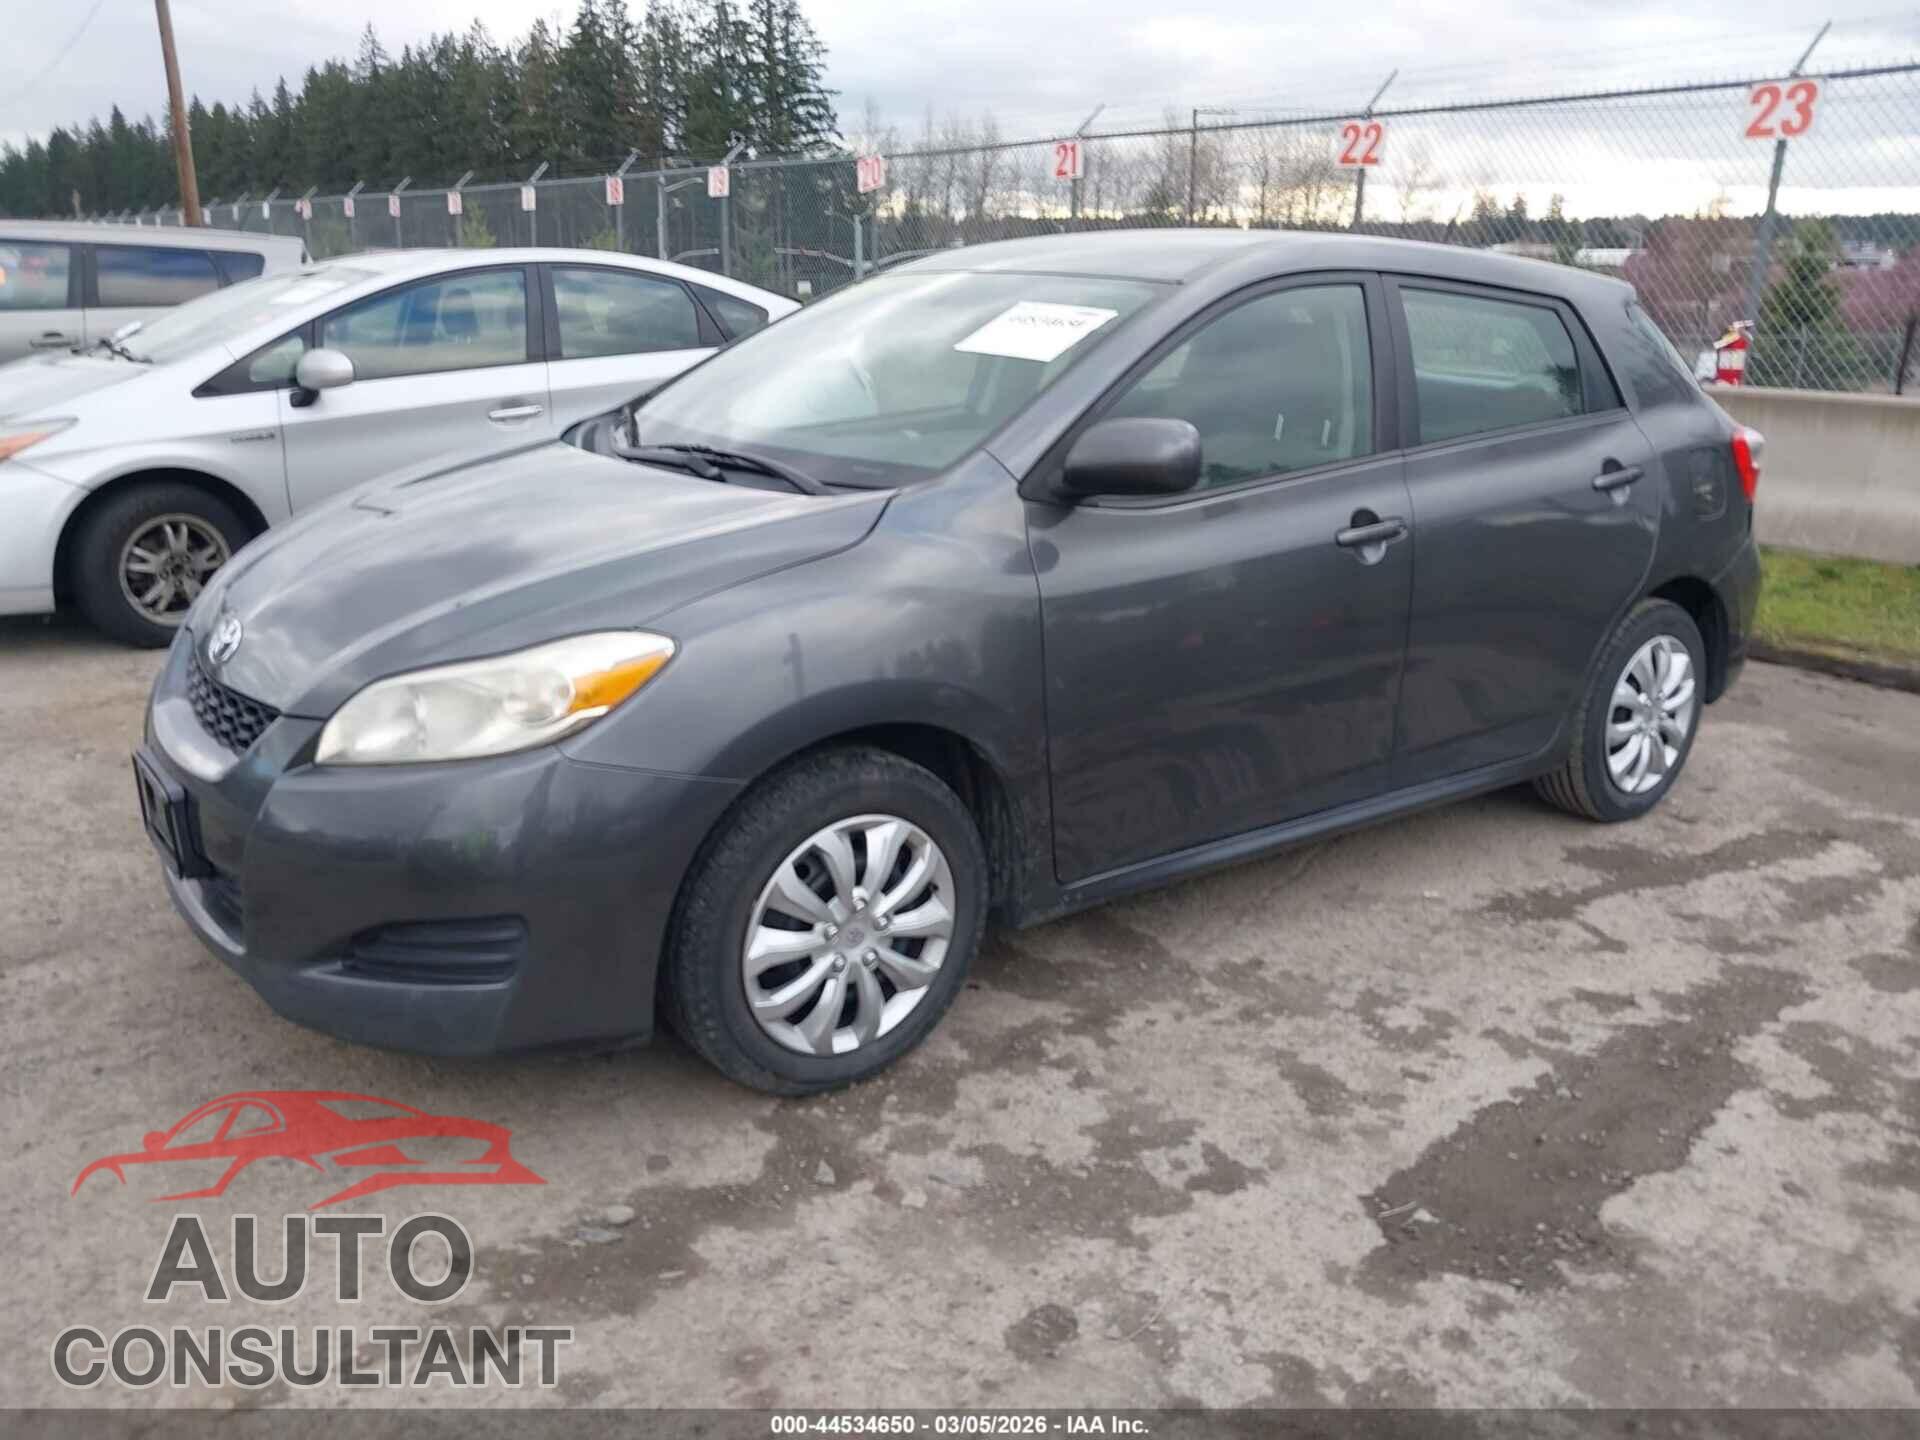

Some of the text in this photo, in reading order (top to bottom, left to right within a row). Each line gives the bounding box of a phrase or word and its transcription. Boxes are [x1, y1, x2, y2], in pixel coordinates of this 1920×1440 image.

[1745, 81, 1818, 137] 23
[1055, 143, 1077, 177] 21
[1339, 122, 1383, 165] 22
